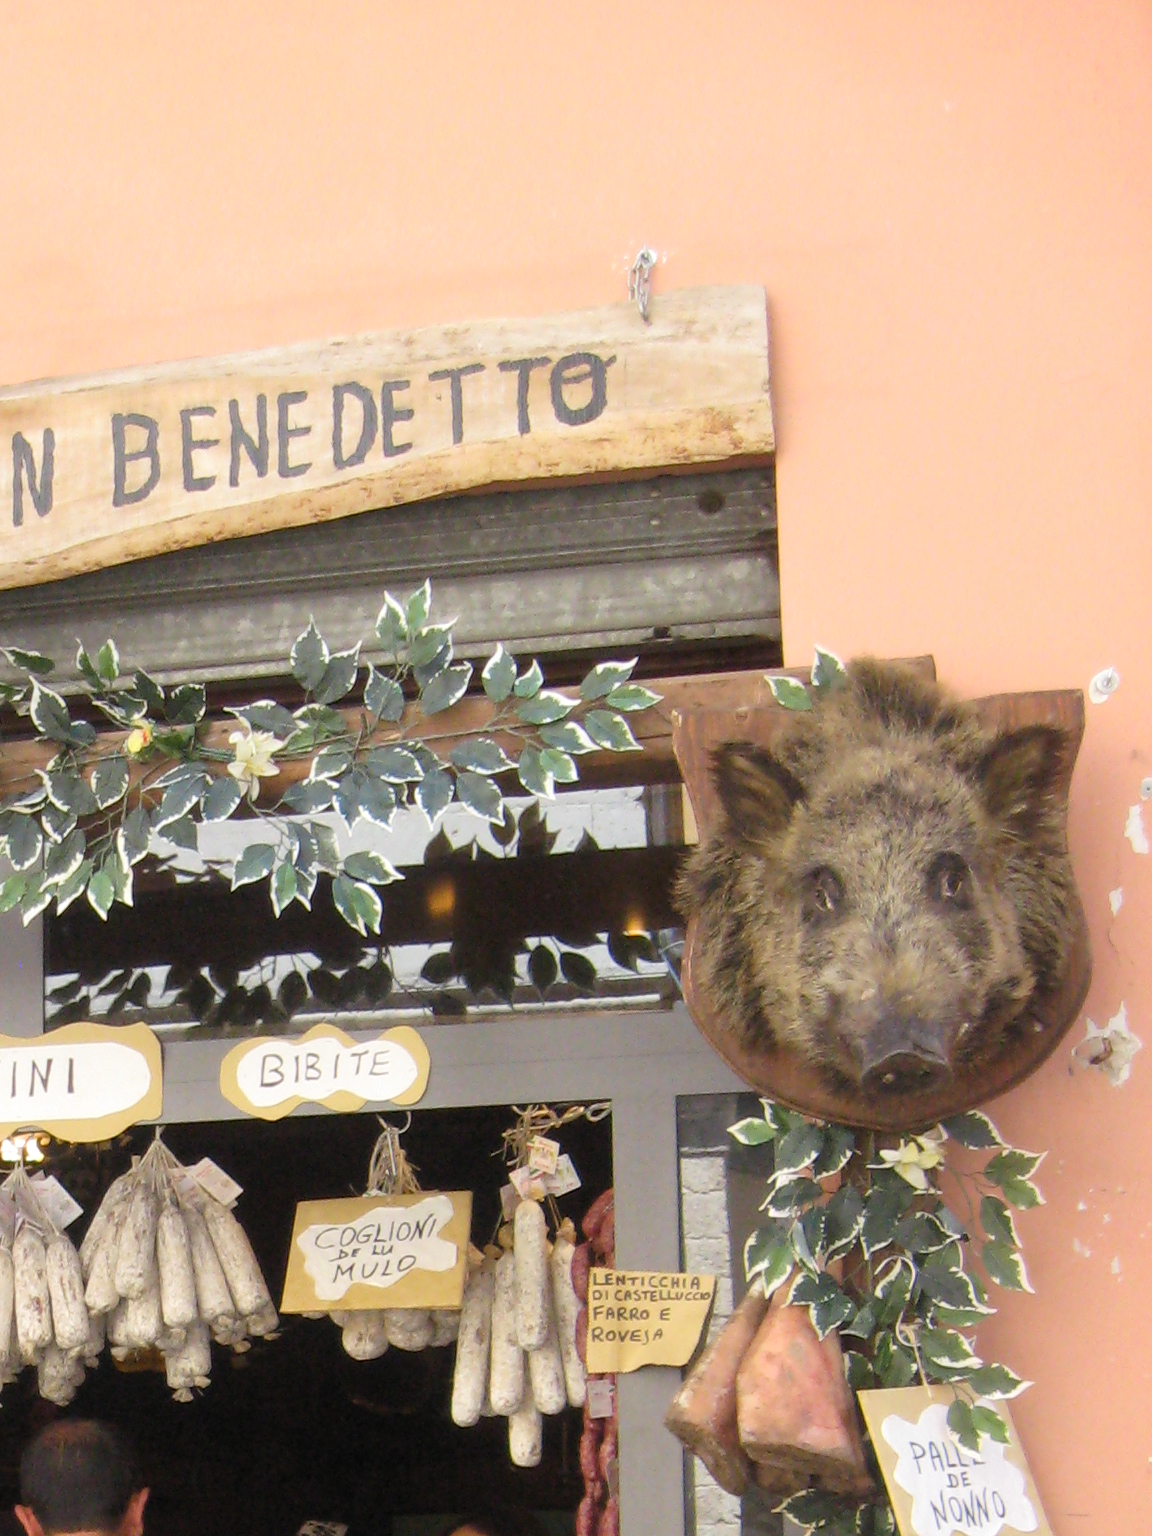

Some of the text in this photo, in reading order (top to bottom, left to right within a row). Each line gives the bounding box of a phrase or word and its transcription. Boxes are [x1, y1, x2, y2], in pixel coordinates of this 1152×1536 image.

[111, 350, 617, 509] BENEDETTO
[259, 1048, 392, 1088] BIBITE
[314, 1213, 436, 1249] COGLIONI
[329, 1244, 394, 1262] DE LU
[332, 1254, 417, 1283] MULO
[592, 1272, 701, 1288] LENTICCHIA
[592, 1289, 711, 1302] DI CASTELLUCCIO
[592, 1305, 671, 1321] FARRO E
[946, 1471, 971, 1489] DE
[930, 1486, 1006, 1531] NONNO
